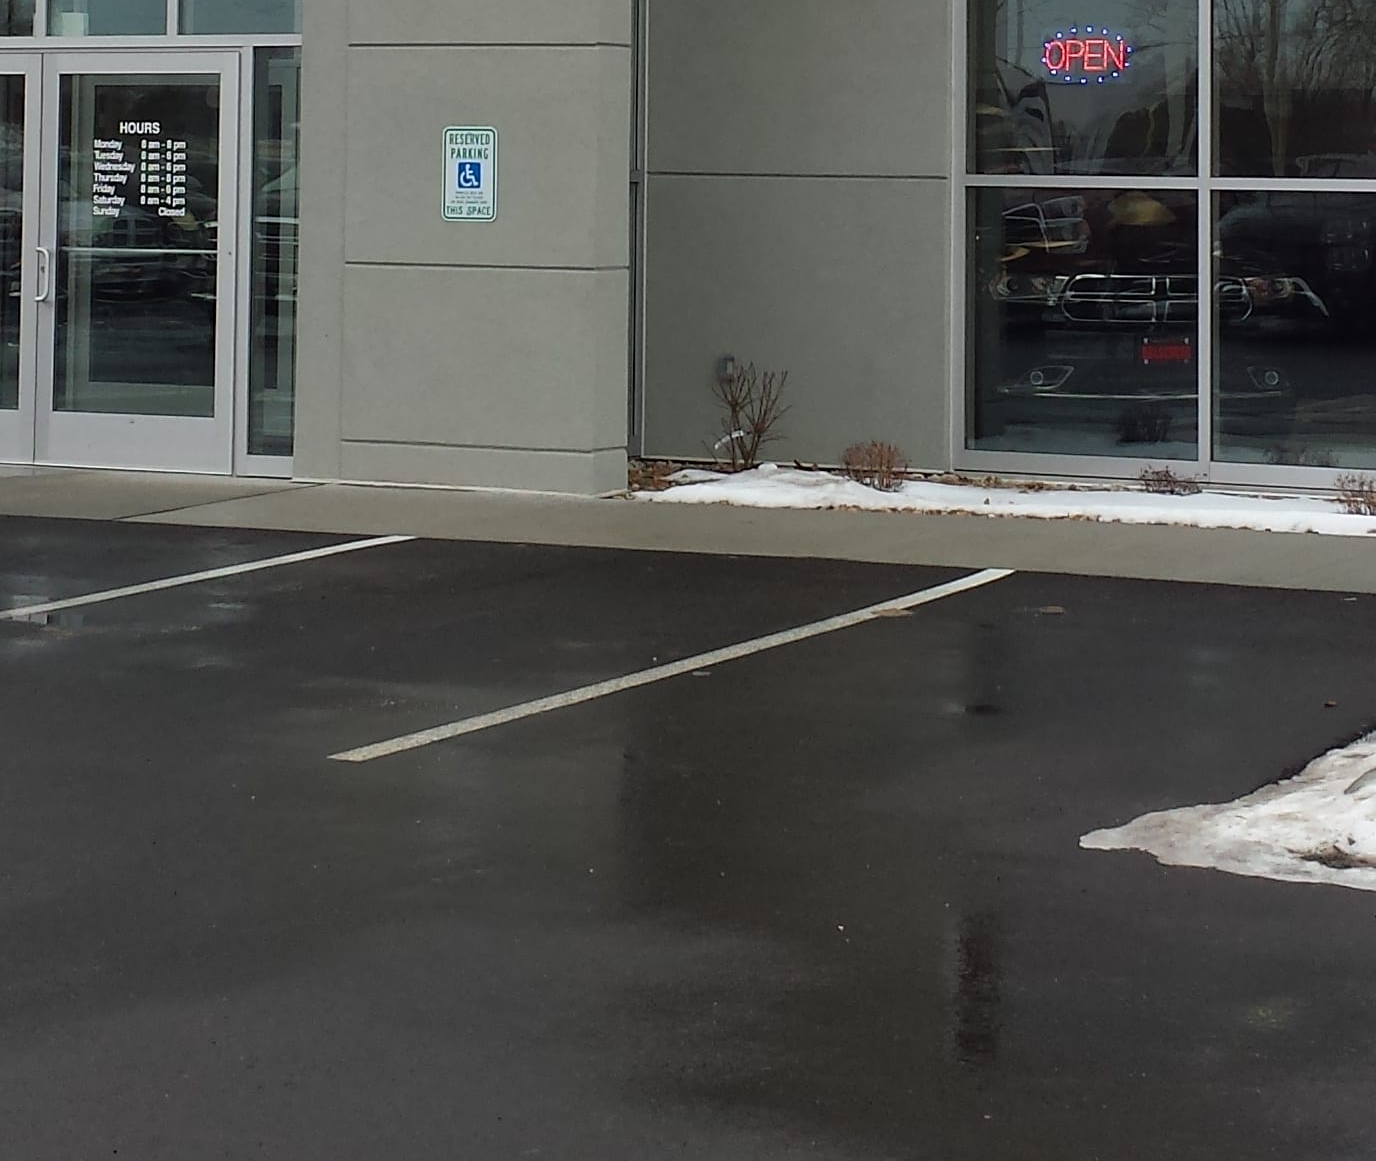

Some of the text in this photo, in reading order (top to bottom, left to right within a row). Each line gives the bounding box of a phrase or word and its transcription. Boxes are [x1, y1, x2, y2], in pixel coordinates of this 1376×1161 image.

[1045, 39, 1124, 71] OPEN
[119, 121, 161, 134] HOURS
[449, 133, 490, 145] RESERVED
[94, 139, 122, 150] Monday
[173, 142, 186, 152] pm
[94, 151, 124, 162] Tuesday
[173, 153, 186, 163] pm
[451, 148, 488, 159] PARKING
[94, 162, 136, 173] Wednesday
[173, 164, 186, 174] pm
[93, 173, 128, 184] Thursday
[173, 175, 186, 185] pm
[93, 184, 115, 195] Friday
[172, 186, 185, 196] pm
[93, 195, 125, 207] Saturday
[172, 198, 185, 208] pm
[93, 206, 185, 217] Sunday Closed
[446, 206, 491, 216] THIS SPACE
